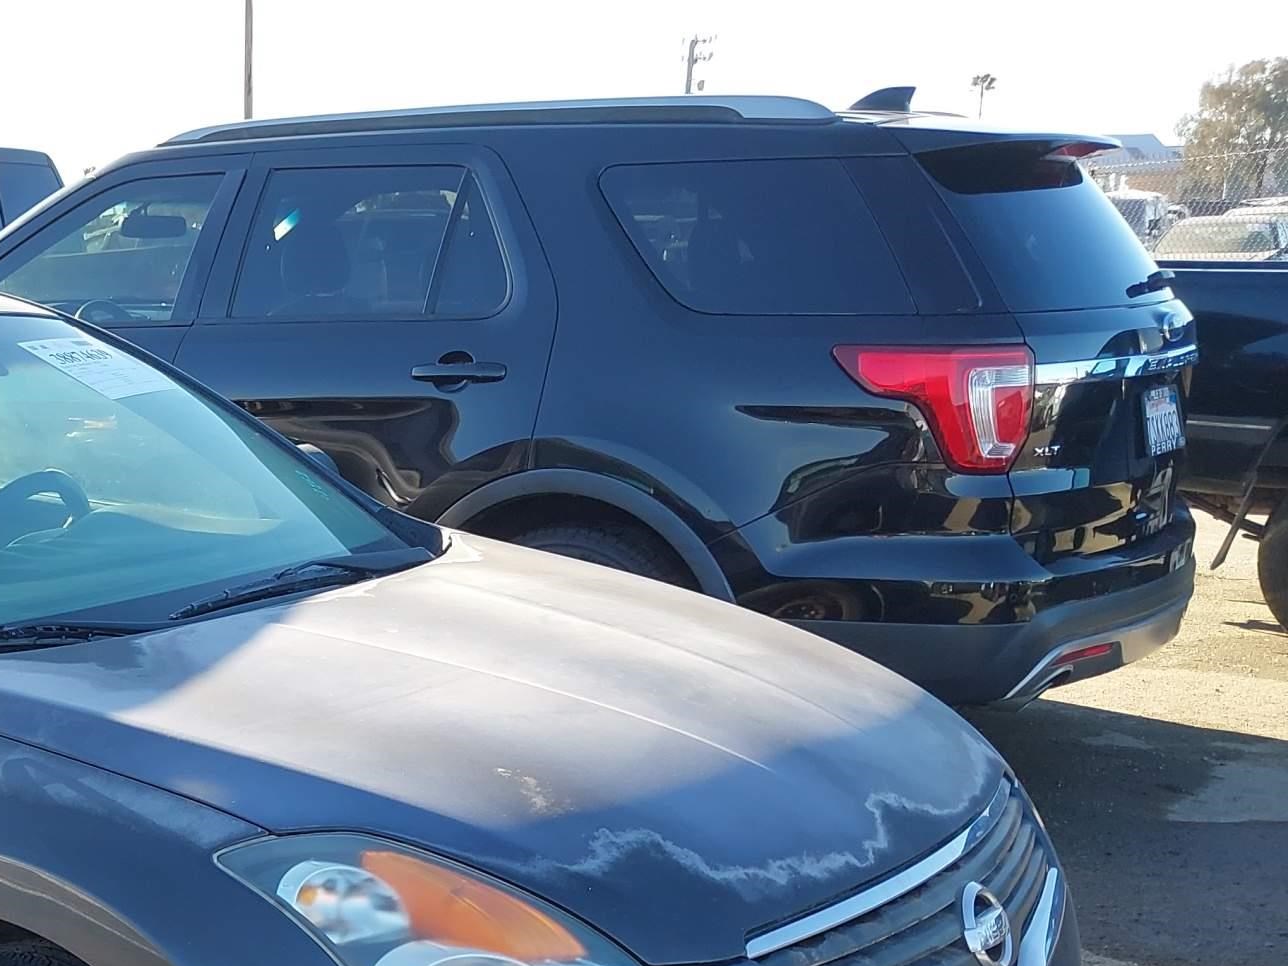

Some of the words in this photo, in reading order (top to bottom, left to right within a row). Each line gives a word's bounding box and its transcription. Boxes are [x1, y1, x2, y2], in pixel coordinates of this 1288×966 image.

[48, 348, 113, 365] 38874639
[1033, 445, 1061, 457] XLT
[1151, 438, 1177, 457] PERRY
